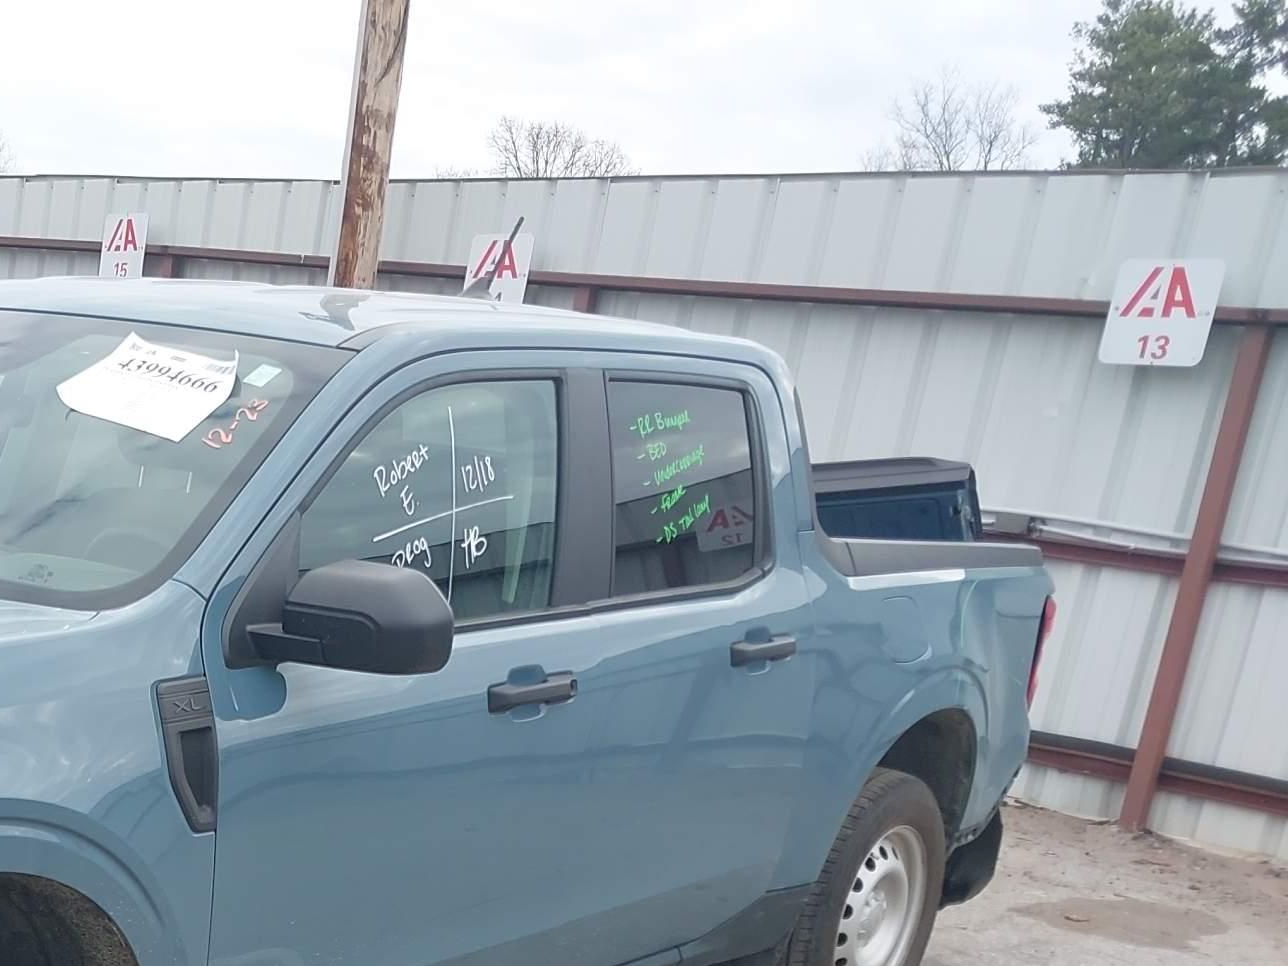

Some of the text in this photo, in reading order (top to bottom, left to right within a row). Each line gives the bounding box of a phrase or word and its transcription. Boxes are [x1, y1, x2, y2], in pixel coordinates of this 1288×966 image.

[114, 262, 128, 277] 15
[1137, 335, 1170, 360] 13
[461, 455, 495, 493] 12/18
[174, 698, 204, 714] XL
